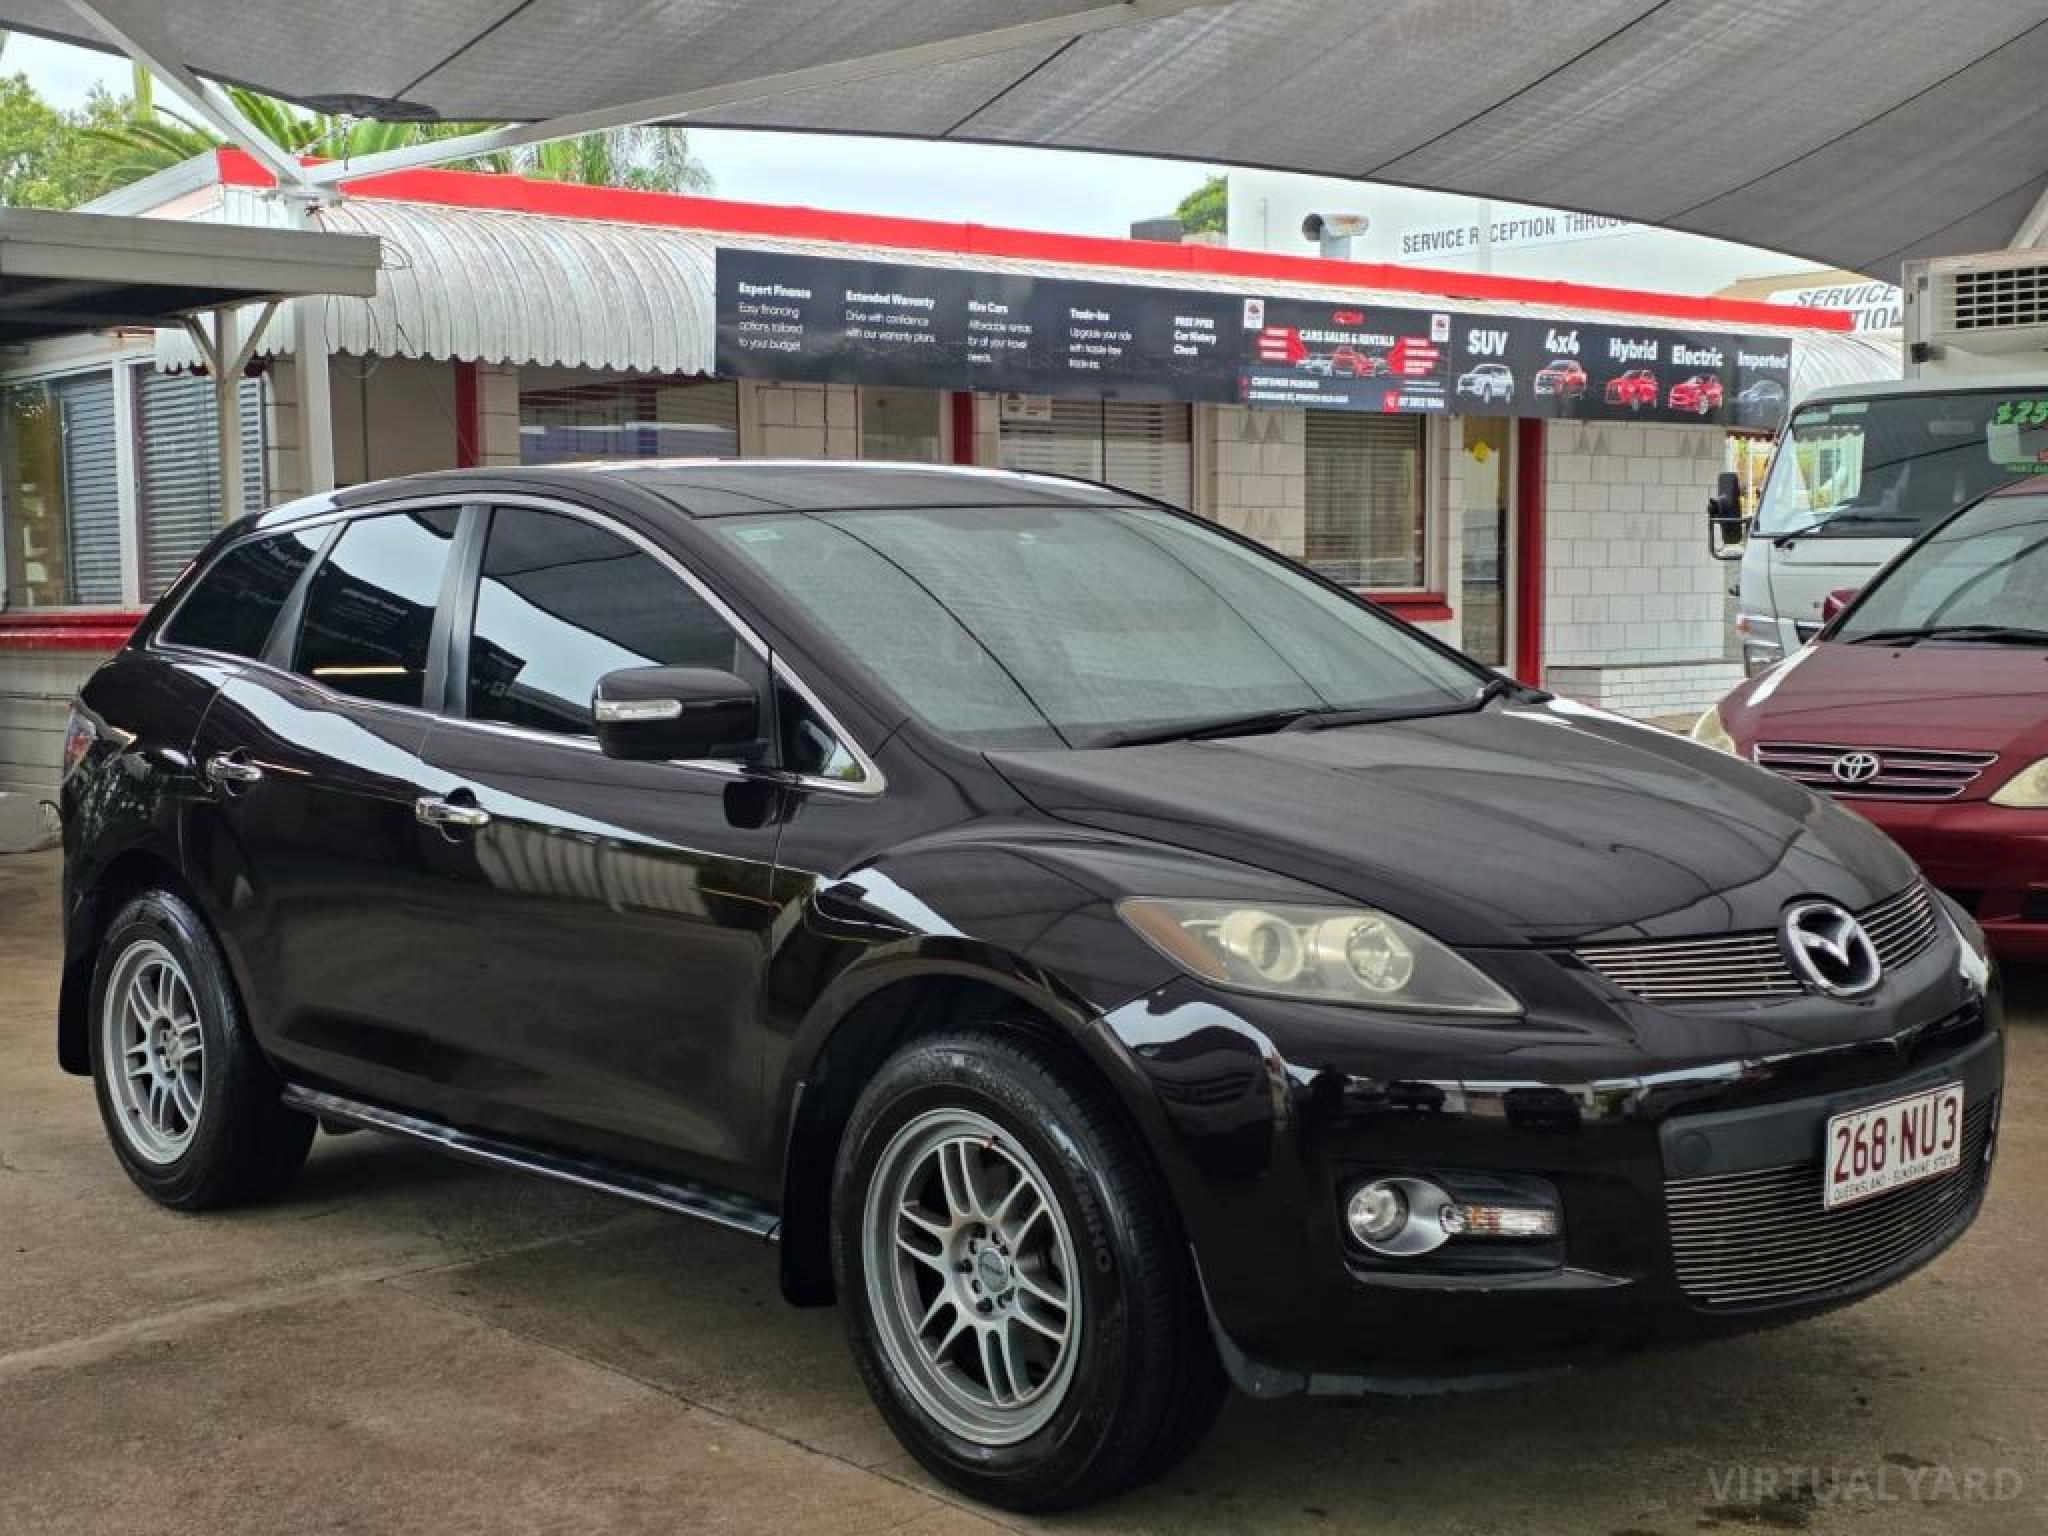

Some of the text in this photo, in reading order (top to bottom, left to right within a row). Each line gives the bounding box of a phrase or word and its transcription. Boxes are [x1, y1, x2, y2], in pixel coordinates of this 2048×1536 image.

[1403, 227, 1464, 254] SERVICE
[1469, 216, 1555, 245] RCEPTION
[738, 282, 812, 299] Expert Finance
[845, 289, 935, 311] Extended Warranty
[738, 302, 800, 319] Easy financing
[845, 310, 866, 322] Drive
[987, 302, 1009, 314] Cars
[749, 338, 767, 350] your
[1467, 329, 1508, 356] SUV
[1545, 329, 1581, 354] 4x4
[1609, 337, 1657, 362] Hybrid
[1672, 344, 1723, 367] Electric
[1737, 351, 1788, 369] Imported
